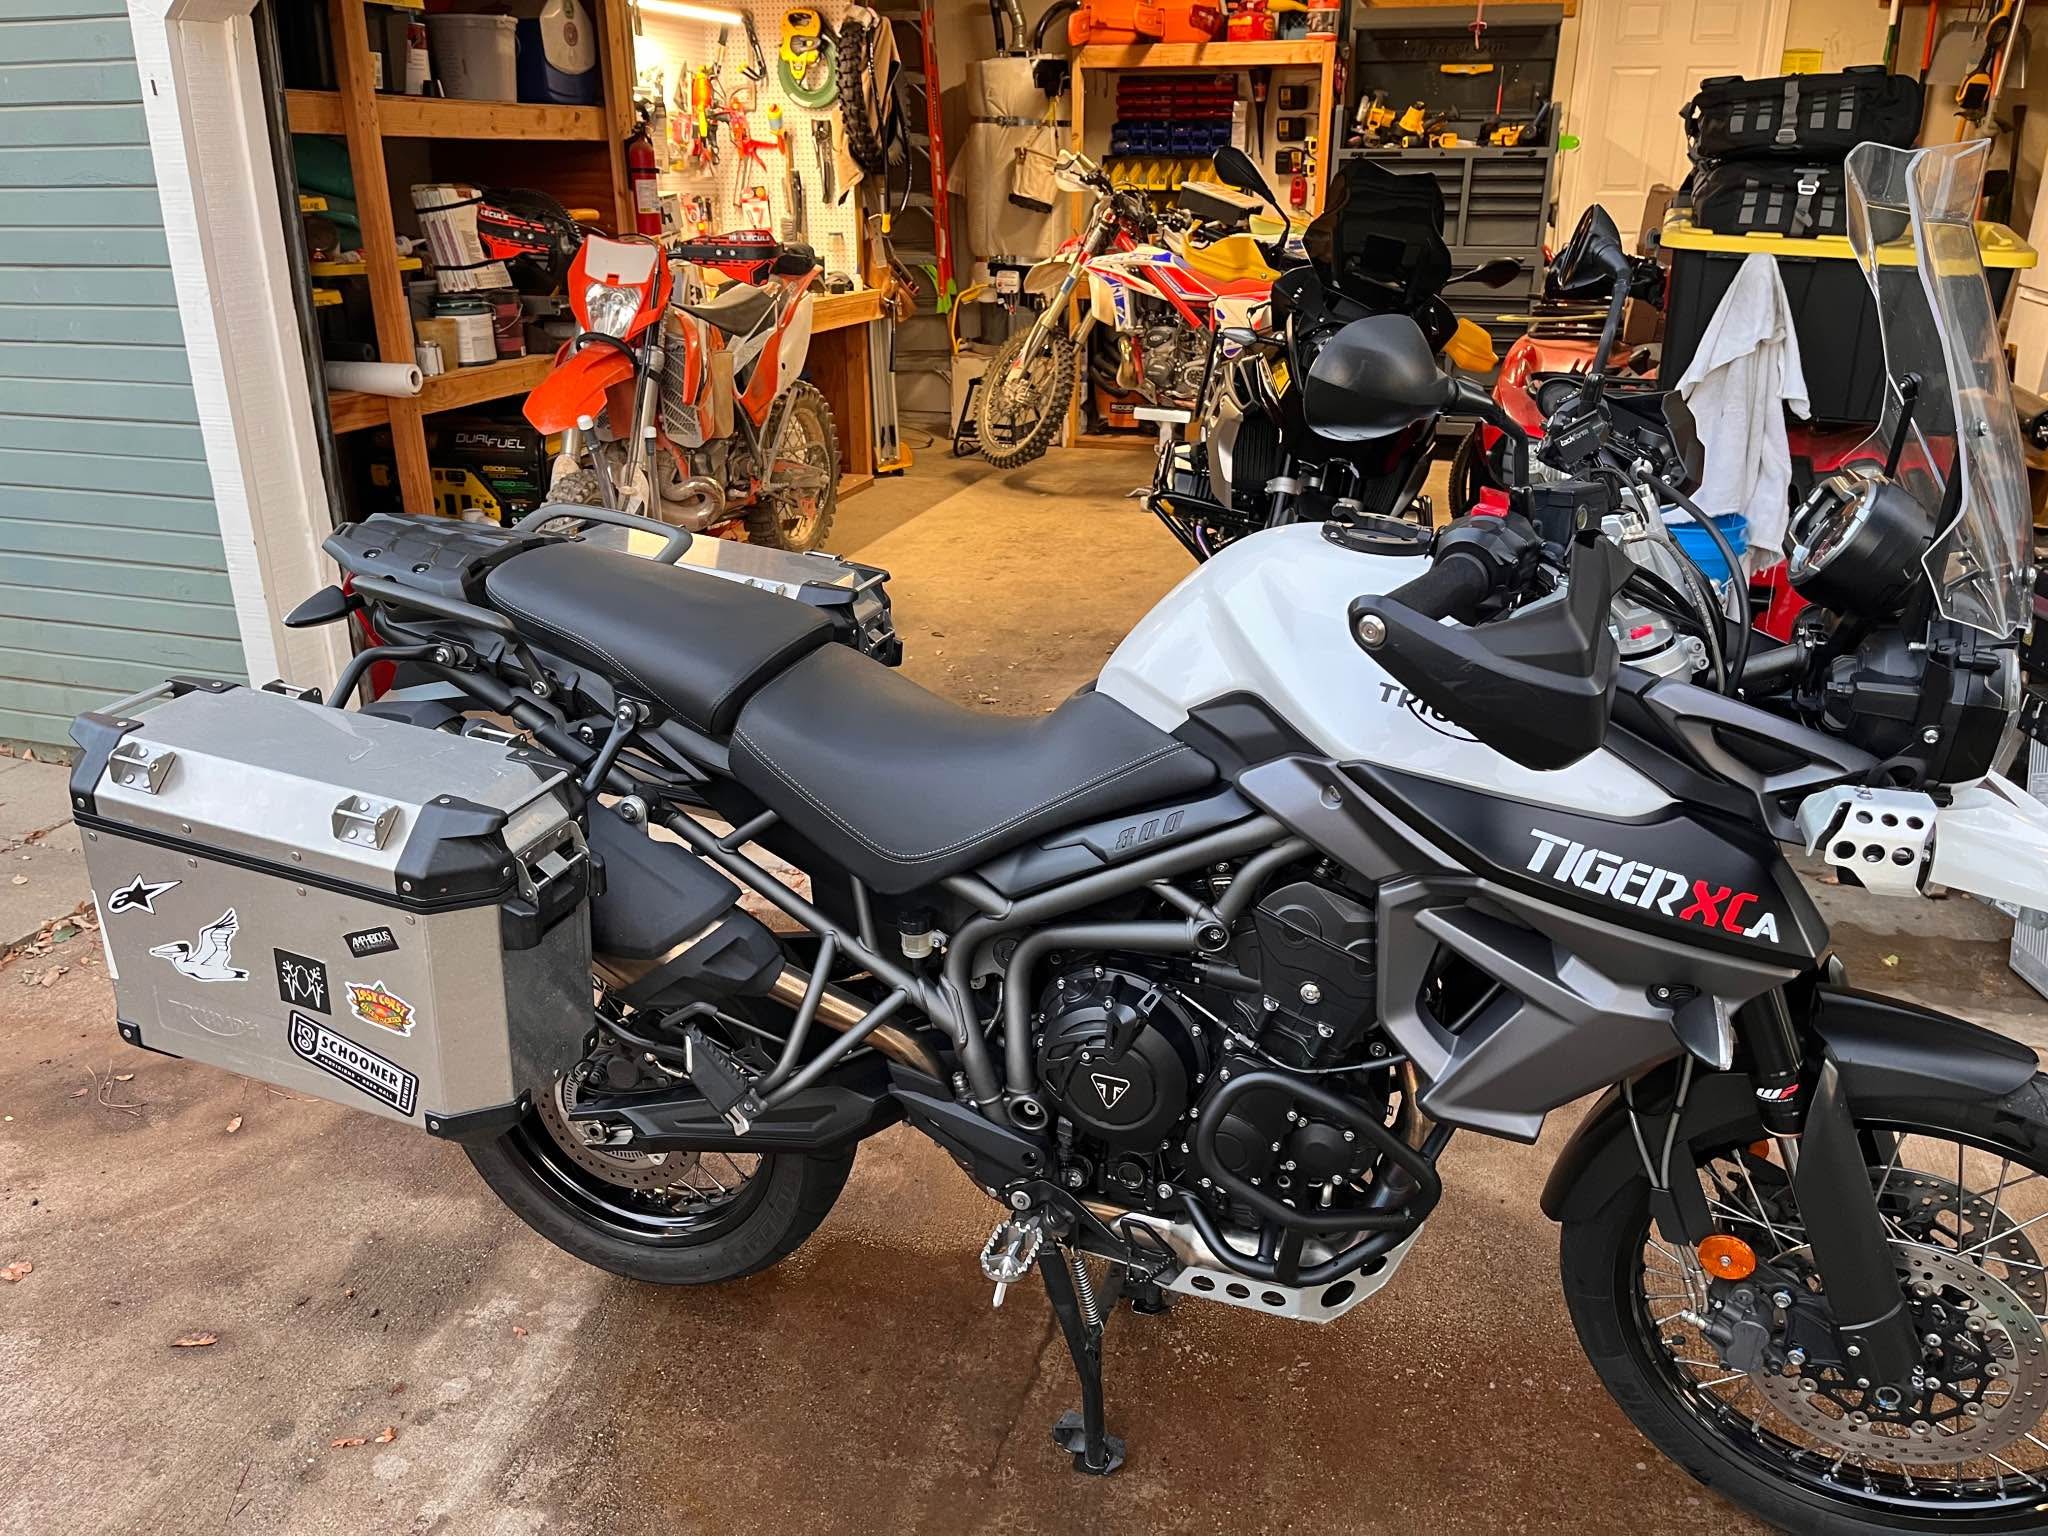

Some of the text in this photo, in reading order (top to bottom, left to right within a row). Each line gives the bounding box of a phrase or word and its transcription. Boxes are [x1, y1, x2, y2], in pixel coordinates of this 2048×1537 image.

[1115, 810, 1185, 850] 800
[1526, 828, 1690, 917] TIGER
[321, 1036, 398, 1087] SCHOONER
